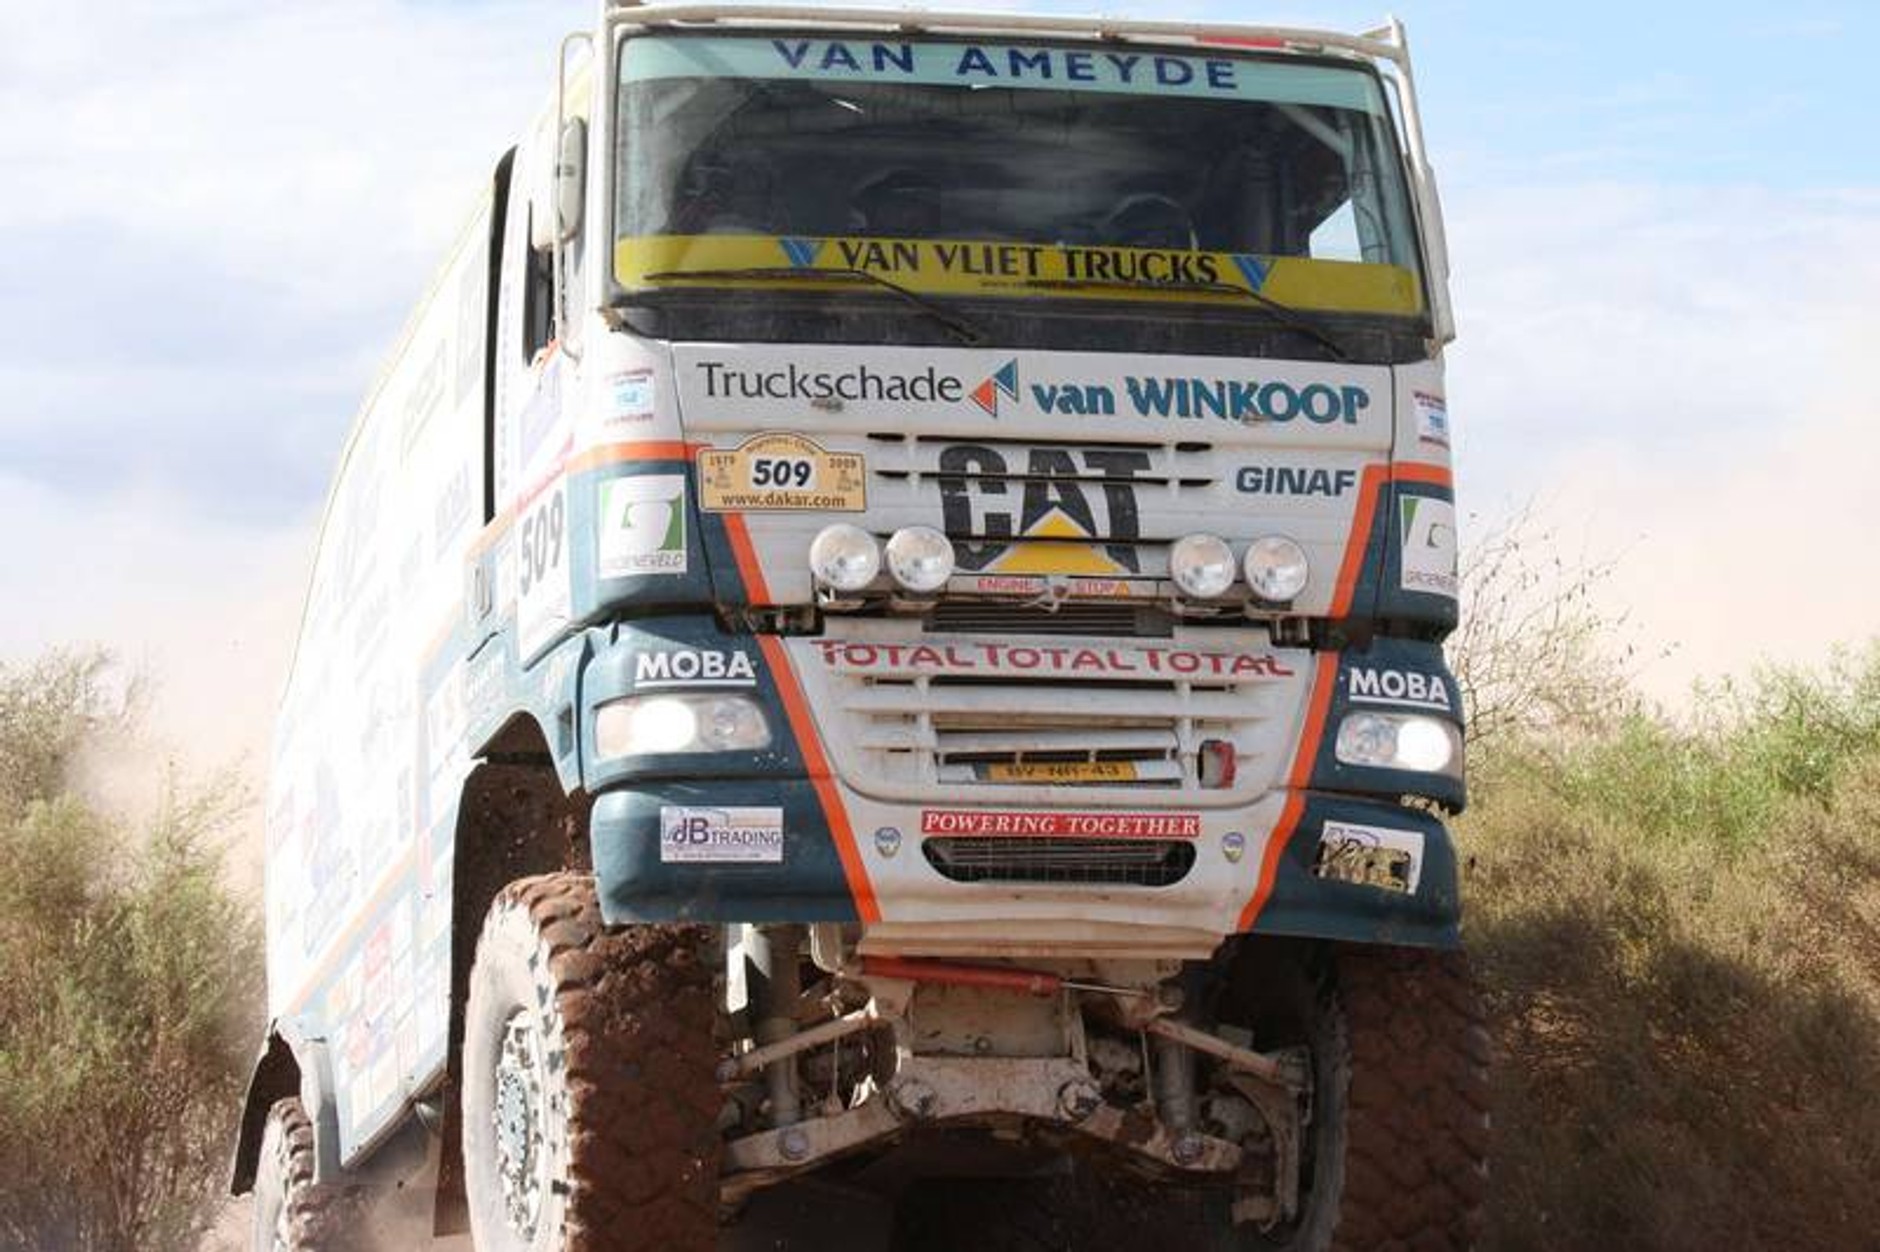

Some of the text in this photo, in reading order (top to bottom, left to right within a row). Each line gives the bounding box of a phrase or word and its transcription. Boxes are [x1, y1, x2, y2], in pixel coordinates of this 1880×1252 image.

[773, 38, 1240, 91] VAN AMEYDE
[837, 240, 1218, 283] VAN VLIET TRUCKS
[696, 362, 963, 403] Truckschade
[1032, 383, 1115, 415] van
[1124, 376, 1371, 424] WINKOOP
[752, 459, 811, 487] 509
[1236, 466, 1357, 497] GINAF
[721, 491, 846, 507] www.dakar.com
[939, 443, 1153, 576] CAT
[520, 490, 564, 597] 509
[635, 650, 756, 681] MOBA
[810, 639, 1295, 677] TOTAL TOTAL TOTAL
[1349, 667, 1449, 705] MOBA
[711, 831, 781, 845] TRADING
[924, 812, 1200, 837] POWERING TOGETHER
